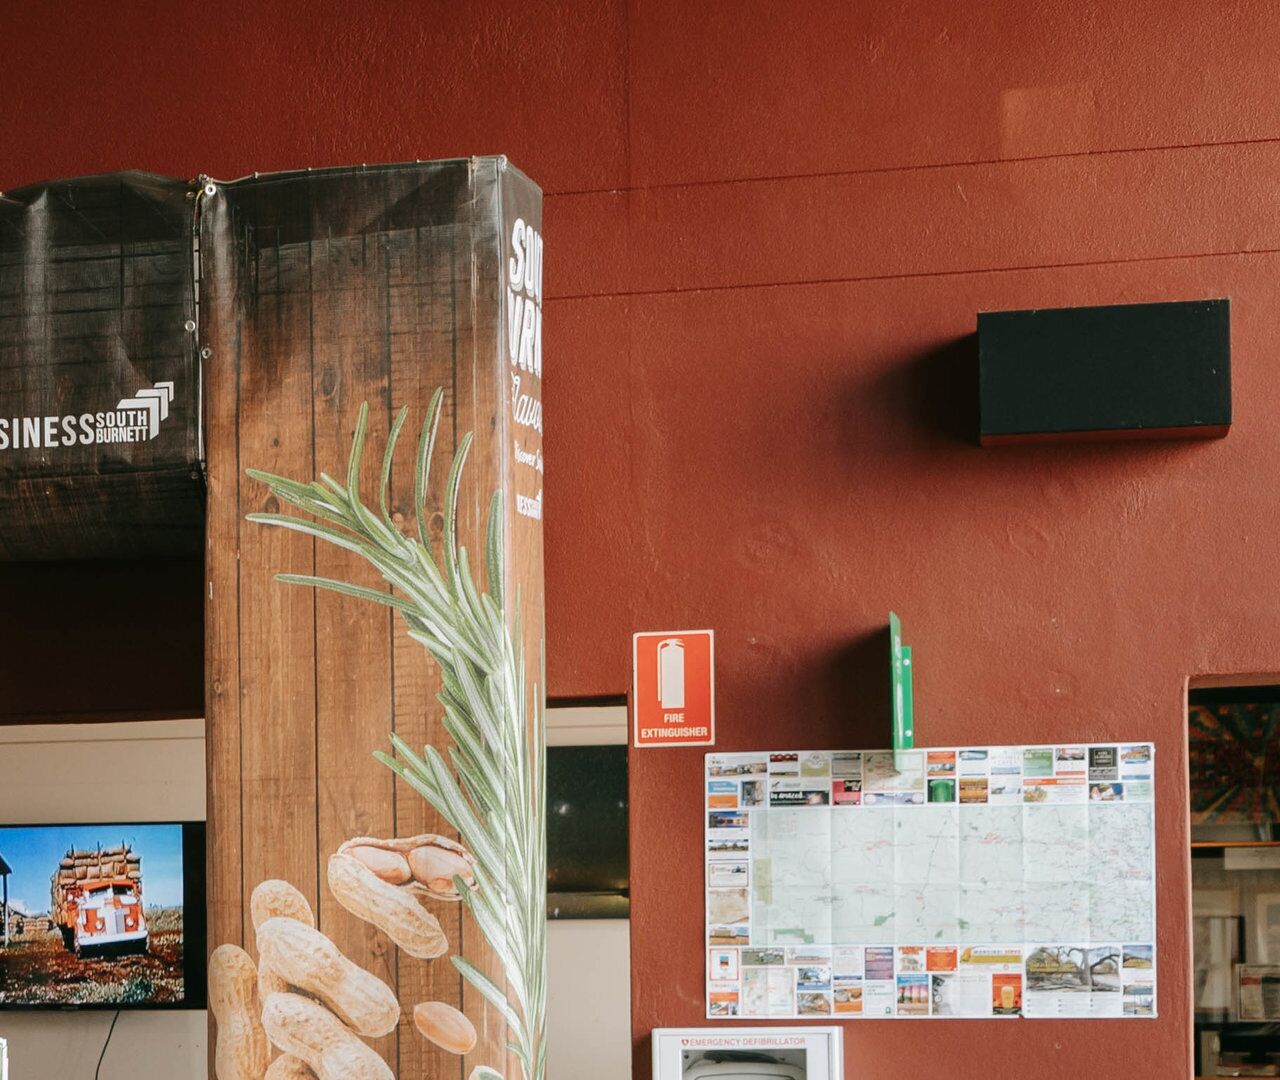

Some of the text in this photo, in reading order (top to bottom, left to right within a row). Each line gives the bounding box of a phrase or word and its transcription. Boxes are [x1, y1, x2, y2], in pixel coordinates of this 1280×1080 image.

[95, 410, 147, 428] SOUTH
[95, 426, 149, 444] BURNETT
[663, 713, 685, 724] FIRE
[640, 726, 708, 739] EXTINGUISHER
[689, 1037, 806, 1047] EMERGENCY DEFIBRILLATOR
